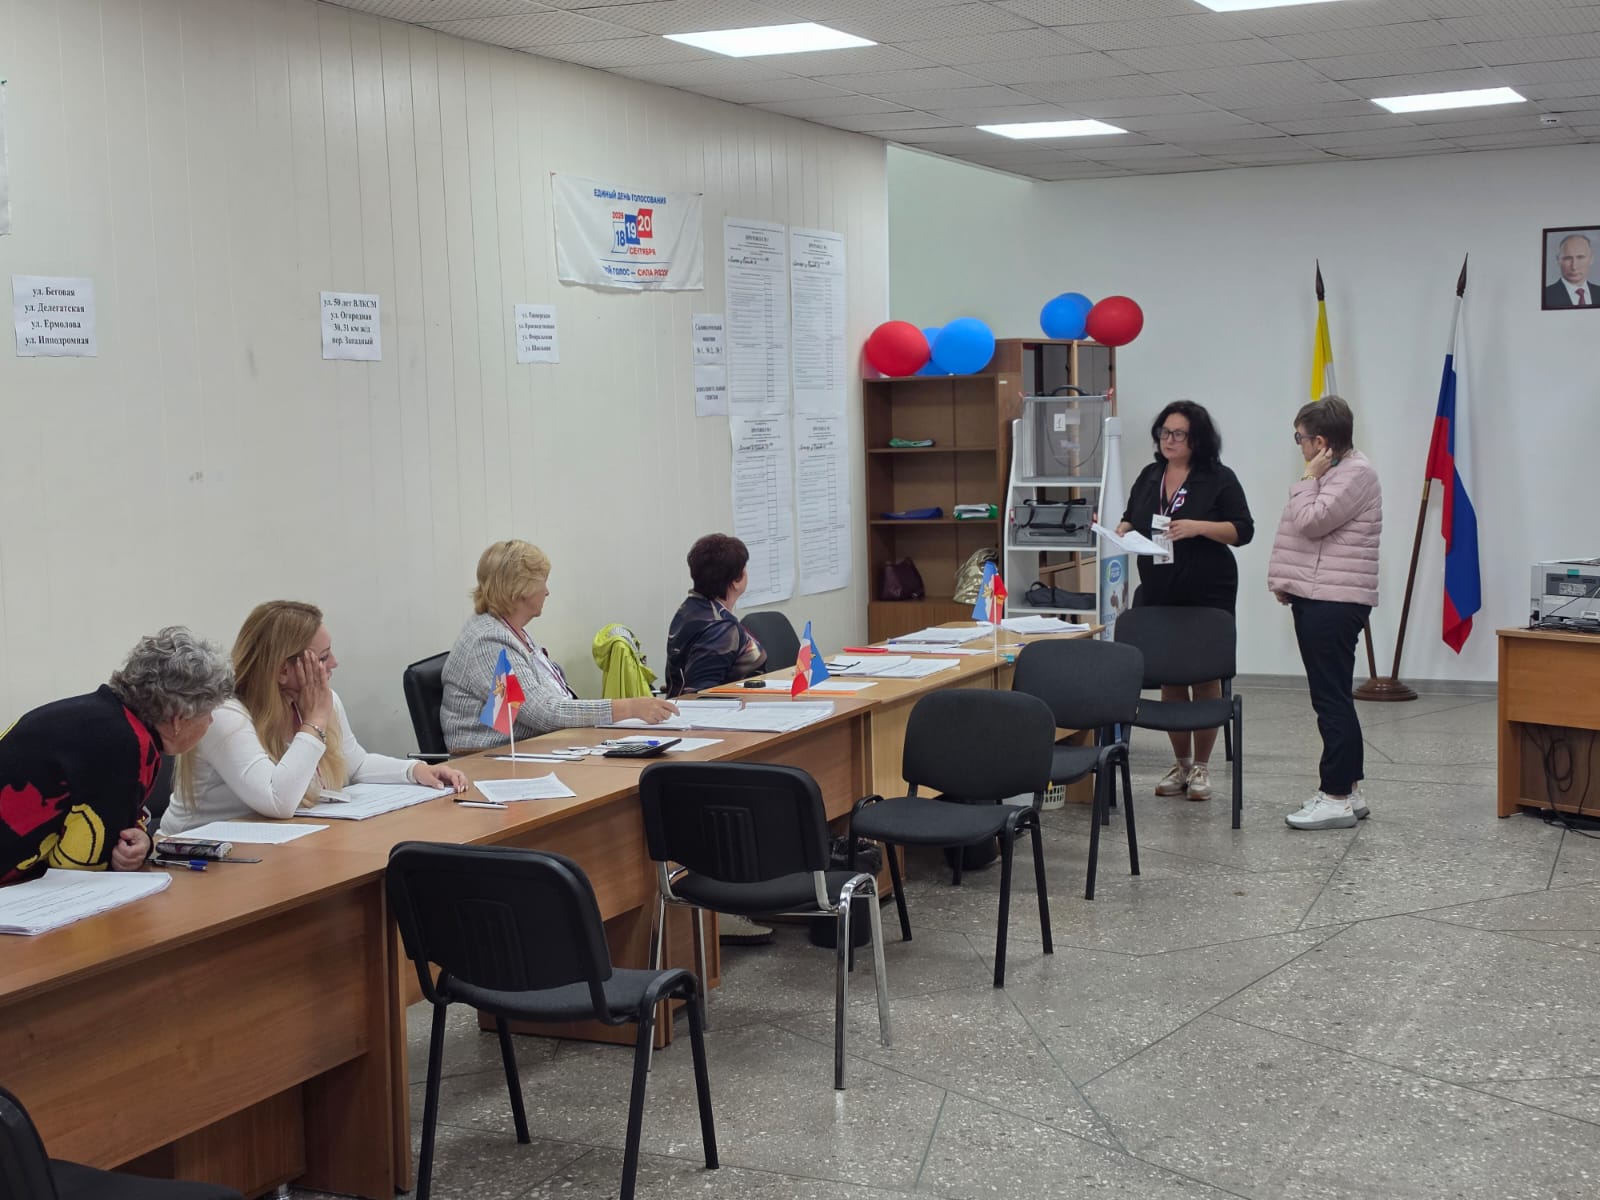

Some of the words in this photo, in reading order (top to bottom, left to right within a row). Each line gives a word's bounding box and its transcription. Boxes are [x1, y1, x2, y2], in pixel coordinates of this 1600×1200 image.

[593, 188, 617, 199] ЕДИНЫЙ
[617, 192, 631, 201] ДЕНЬ
[631, 193, 667, 205] ГОЛОСОВАНИЯ
[638, 215, 651, 232] 20
[626, 221, 637, 239] 19
[616, 230, 626, 247] 18
[629, 246, 656, 256] СЕНТЯБРЯ
[637, 268, 653, 277] СИЛА
[32, 287, 43, 298] ул.
[45, 286, 75, 297] Беговая
[24, 304, 35, 314] ул.
[37, 302, 85, 313] Делегатская
[323, 299, 332, 308] ул.
[353, 299, 377, 308] ВЛКСМ
[330, 311, 339, 321] ул.
[31, 320, 42, 330] ул.
[44, 319, 81, 331] Ермолова
[25, 336, 36, 347] ул.
[38, 335, 89, 347] Ипподромная
